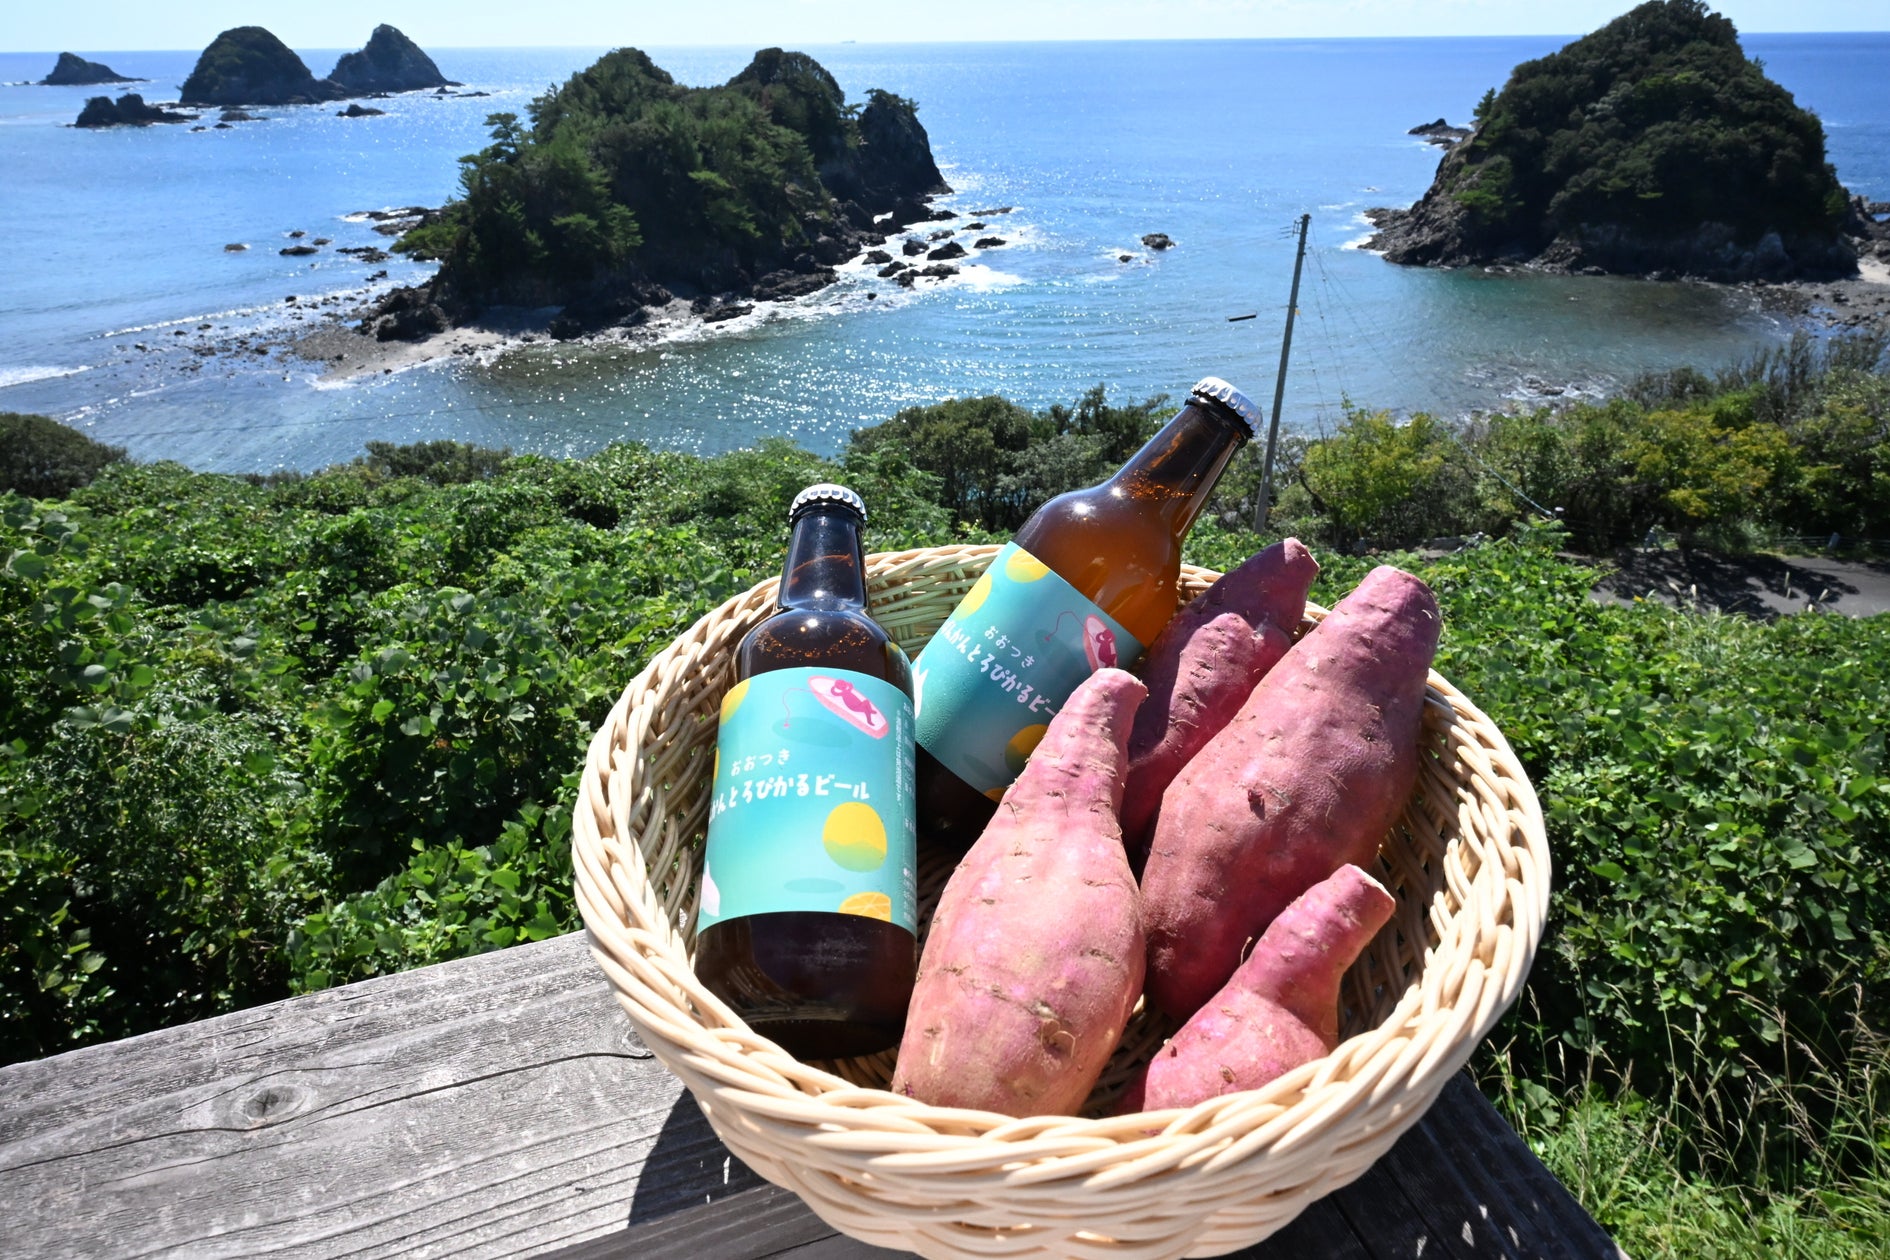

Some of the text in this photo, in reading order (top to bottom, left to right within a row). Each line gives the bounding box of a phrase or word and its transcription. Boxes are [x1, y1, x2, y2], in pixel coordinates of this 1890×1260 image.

[984, 625, 1036, 668] おおつき
[730, 748, 790, 777] おおつき
[708, 773, 870, 825] かんとろぴかるビール
